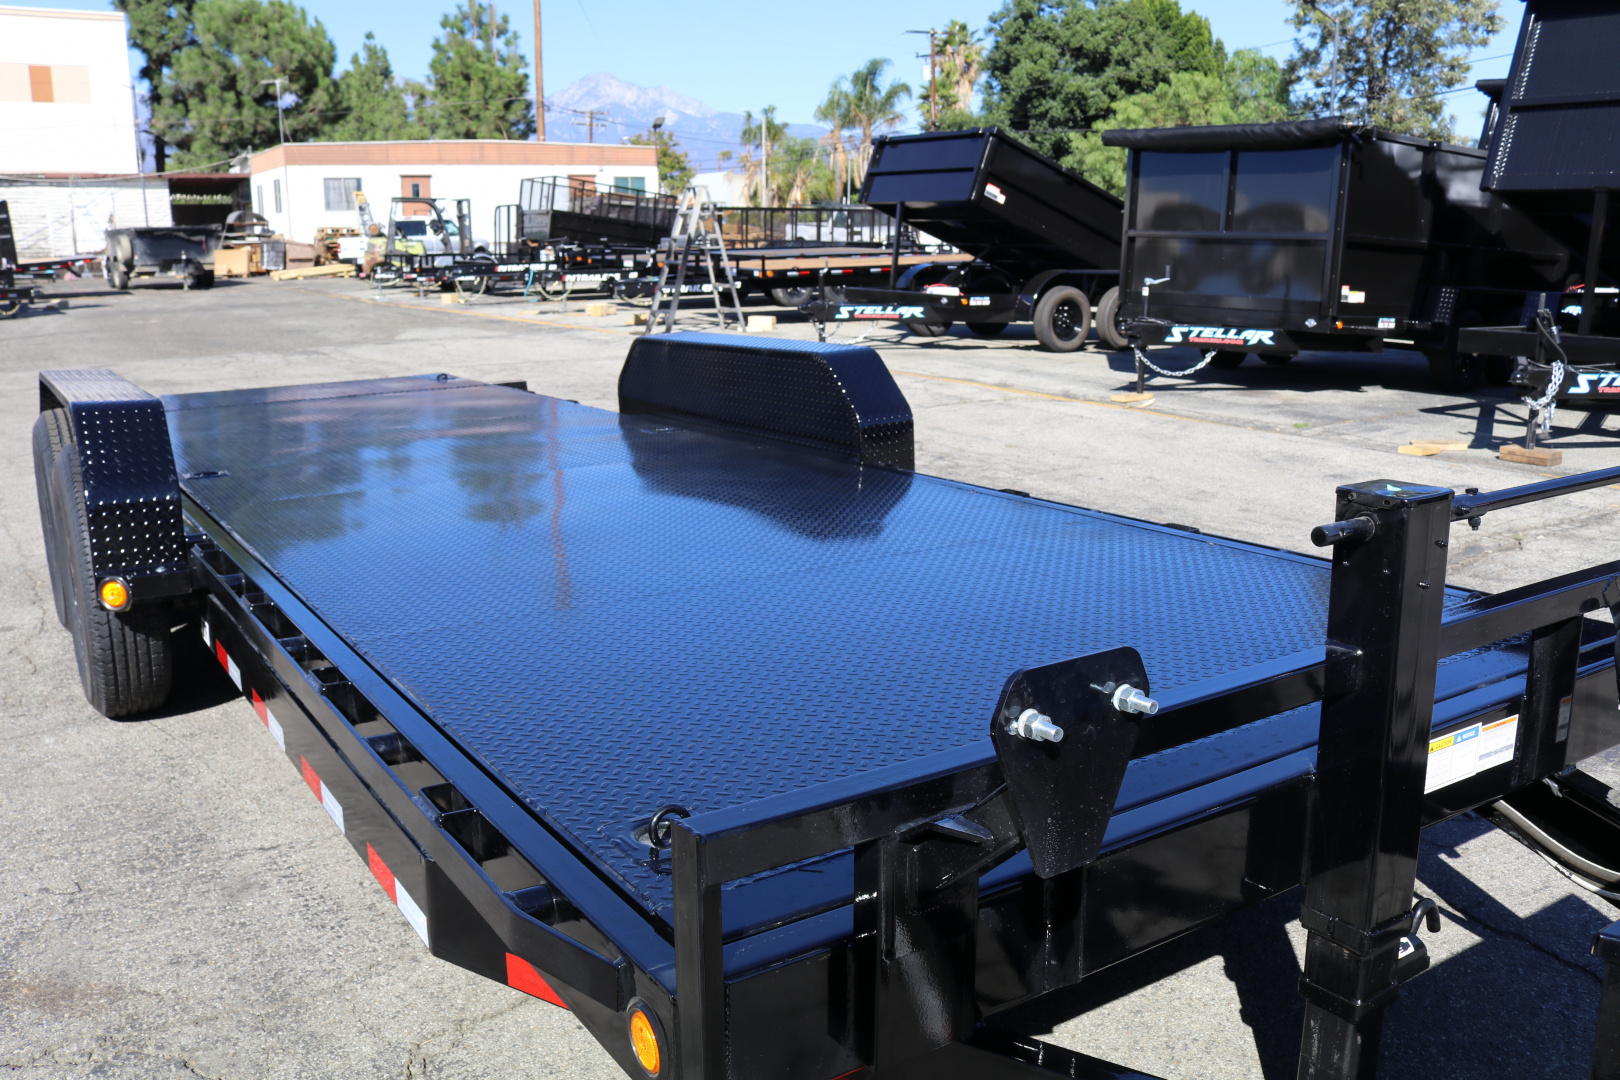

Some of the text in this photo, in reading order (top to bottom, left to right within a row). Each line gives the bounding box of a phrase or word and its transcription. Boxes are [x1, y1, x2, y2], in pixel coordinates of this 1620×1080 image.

[835, 305, 925, 319] STELLAR
[1164, 326, 1275, 345] STELLAR
[1462, 731, 1476, 740] NOTICE
[1435, 739, 1452, 749] CAUTION
